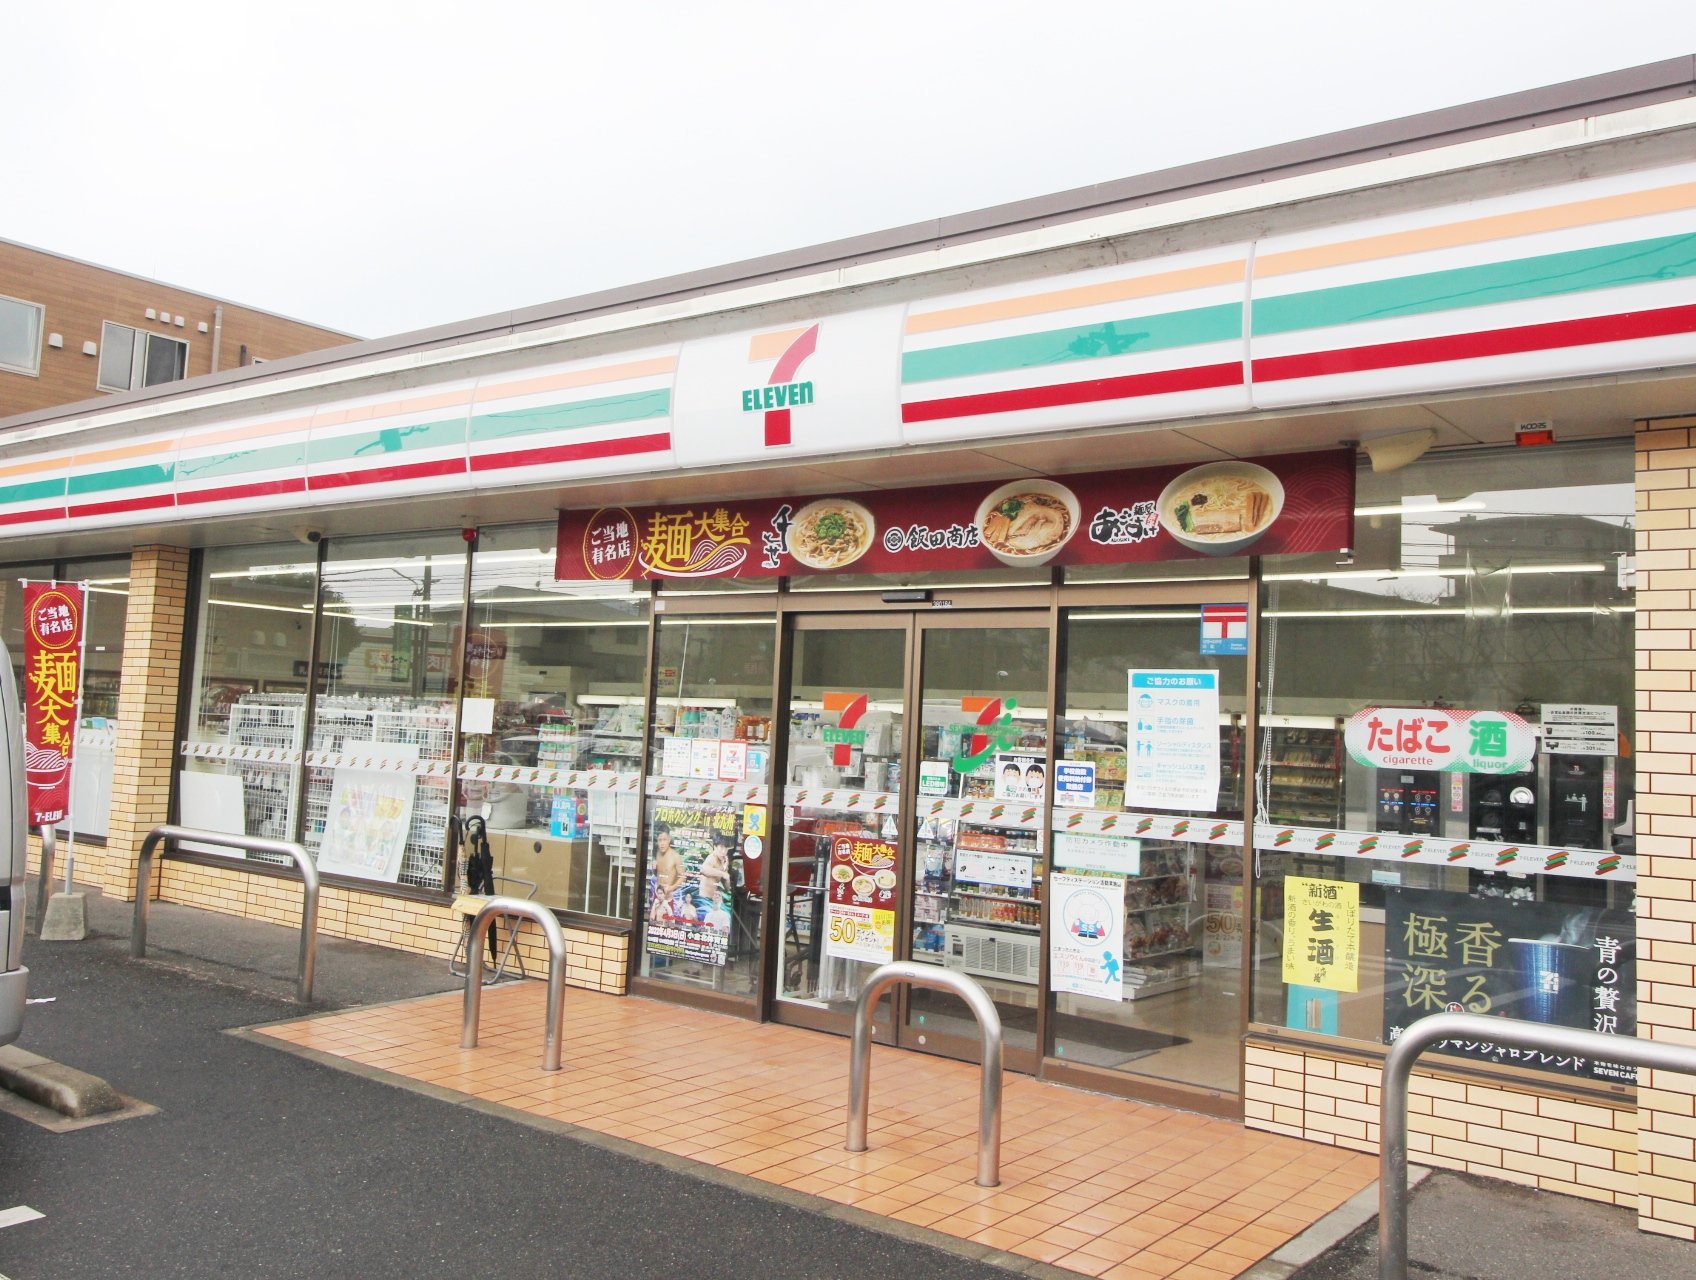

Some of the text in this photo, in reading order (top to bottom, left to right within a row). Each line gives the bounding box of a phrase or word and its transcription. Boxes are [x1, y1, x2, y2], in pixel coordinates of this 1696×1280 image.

[591, 520, 630, 546] ご当地
[641, 508, 751, 577] 麺大集合
[905, 524, 979, 549] 飯田商店
[591, 540, 631, 566] 有名店
[38, 605, 70, 622] ご当地
[39, 617, 73, 635] 有名店
[1146, 676, 1202, 686] ご協力のお願い
[29, 649, 77, 757] 麺大集合
[1367, 717, 1508, 757] たばこ 酒
[1382, 755, 1508, 769] cigarette liquor
[655, 807, 702, 826] プロボクシング
[829, 916, 856, 943] 50
[1307, 908, 1335, 965] 生酒
[1401, 912, 1503, 1014] 香る 極深
[1593, 936, 1622, 1034] 青の贅沢
[1593, 1067, 1638, 1080] SEVEN CAF
